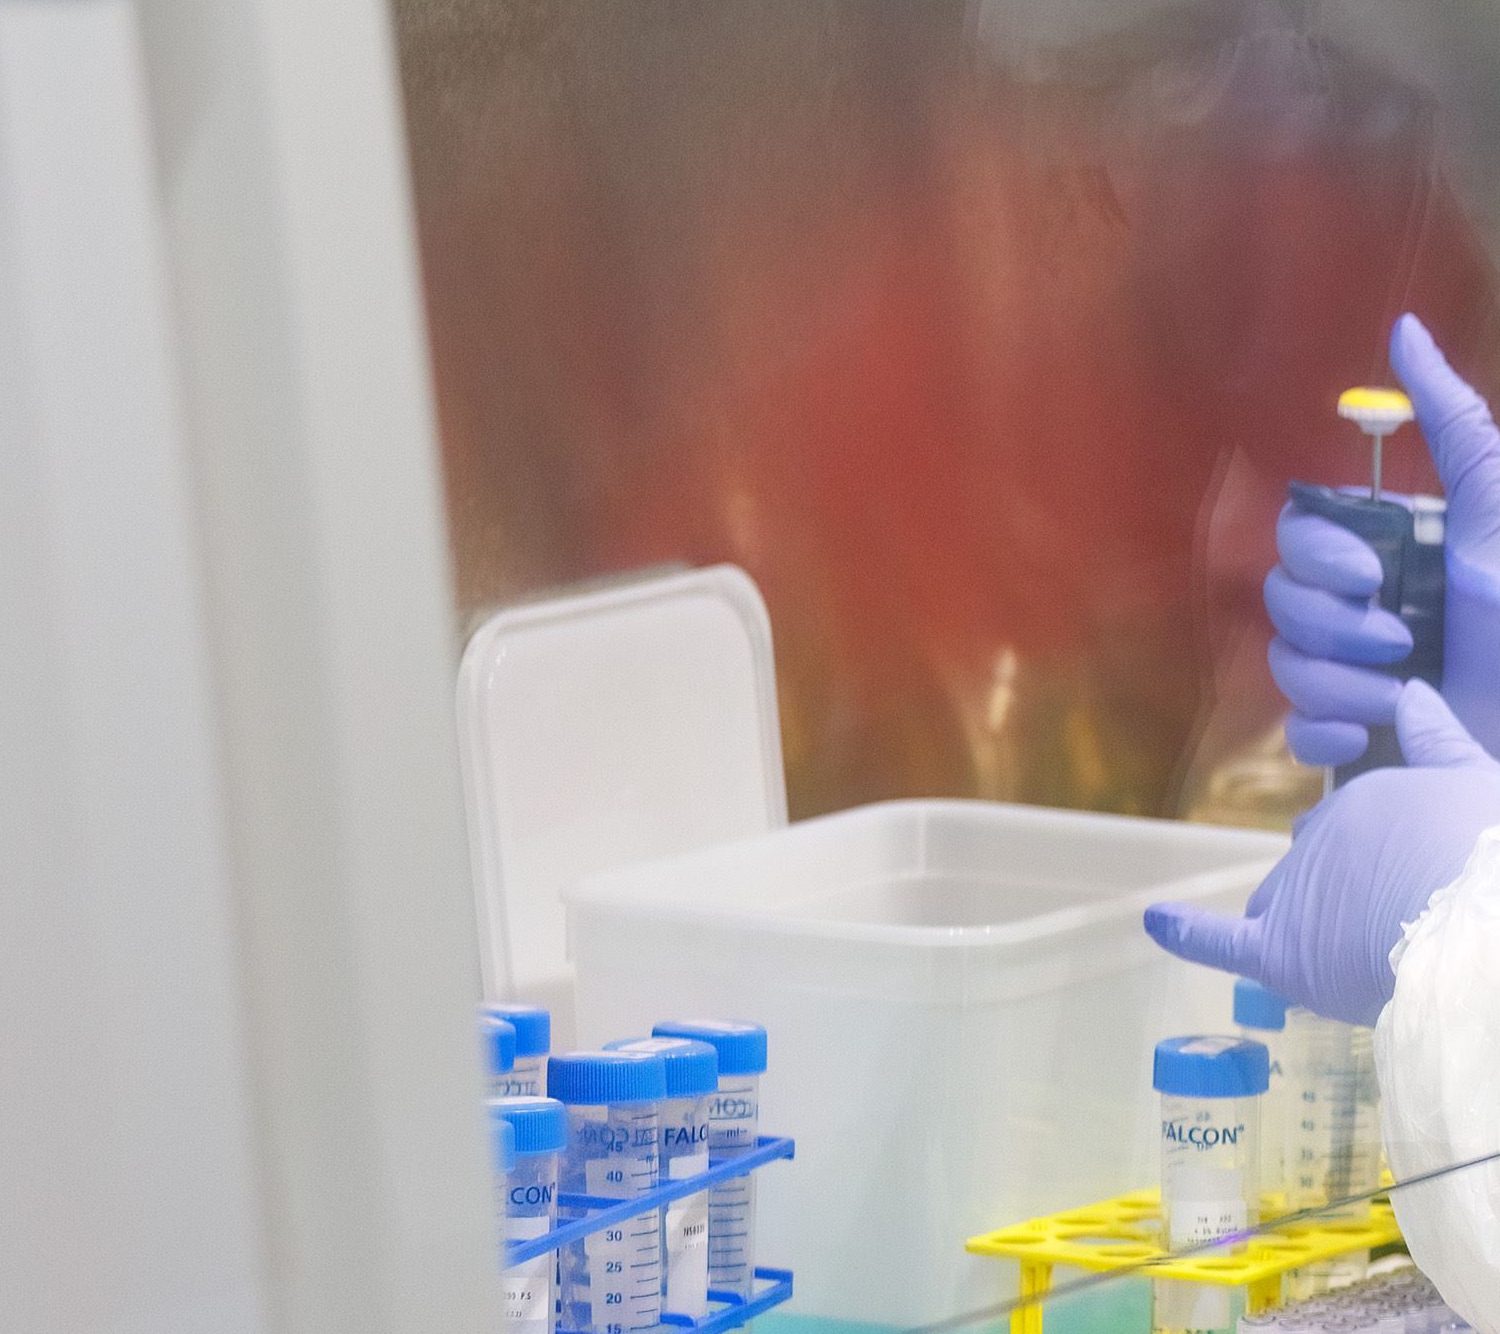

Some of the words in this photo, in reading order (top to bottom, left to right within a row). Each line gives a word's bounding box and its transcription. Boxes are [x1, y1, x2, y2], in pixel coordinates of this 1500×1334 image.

[606, 1170, 623, 1182] 40
[606, 1229, 622, 1242] 30
[606, 1262, 622, 1273] 25
[606, 1292, 622, 1304] 20
[607, 1324, 621, 1334] 15
